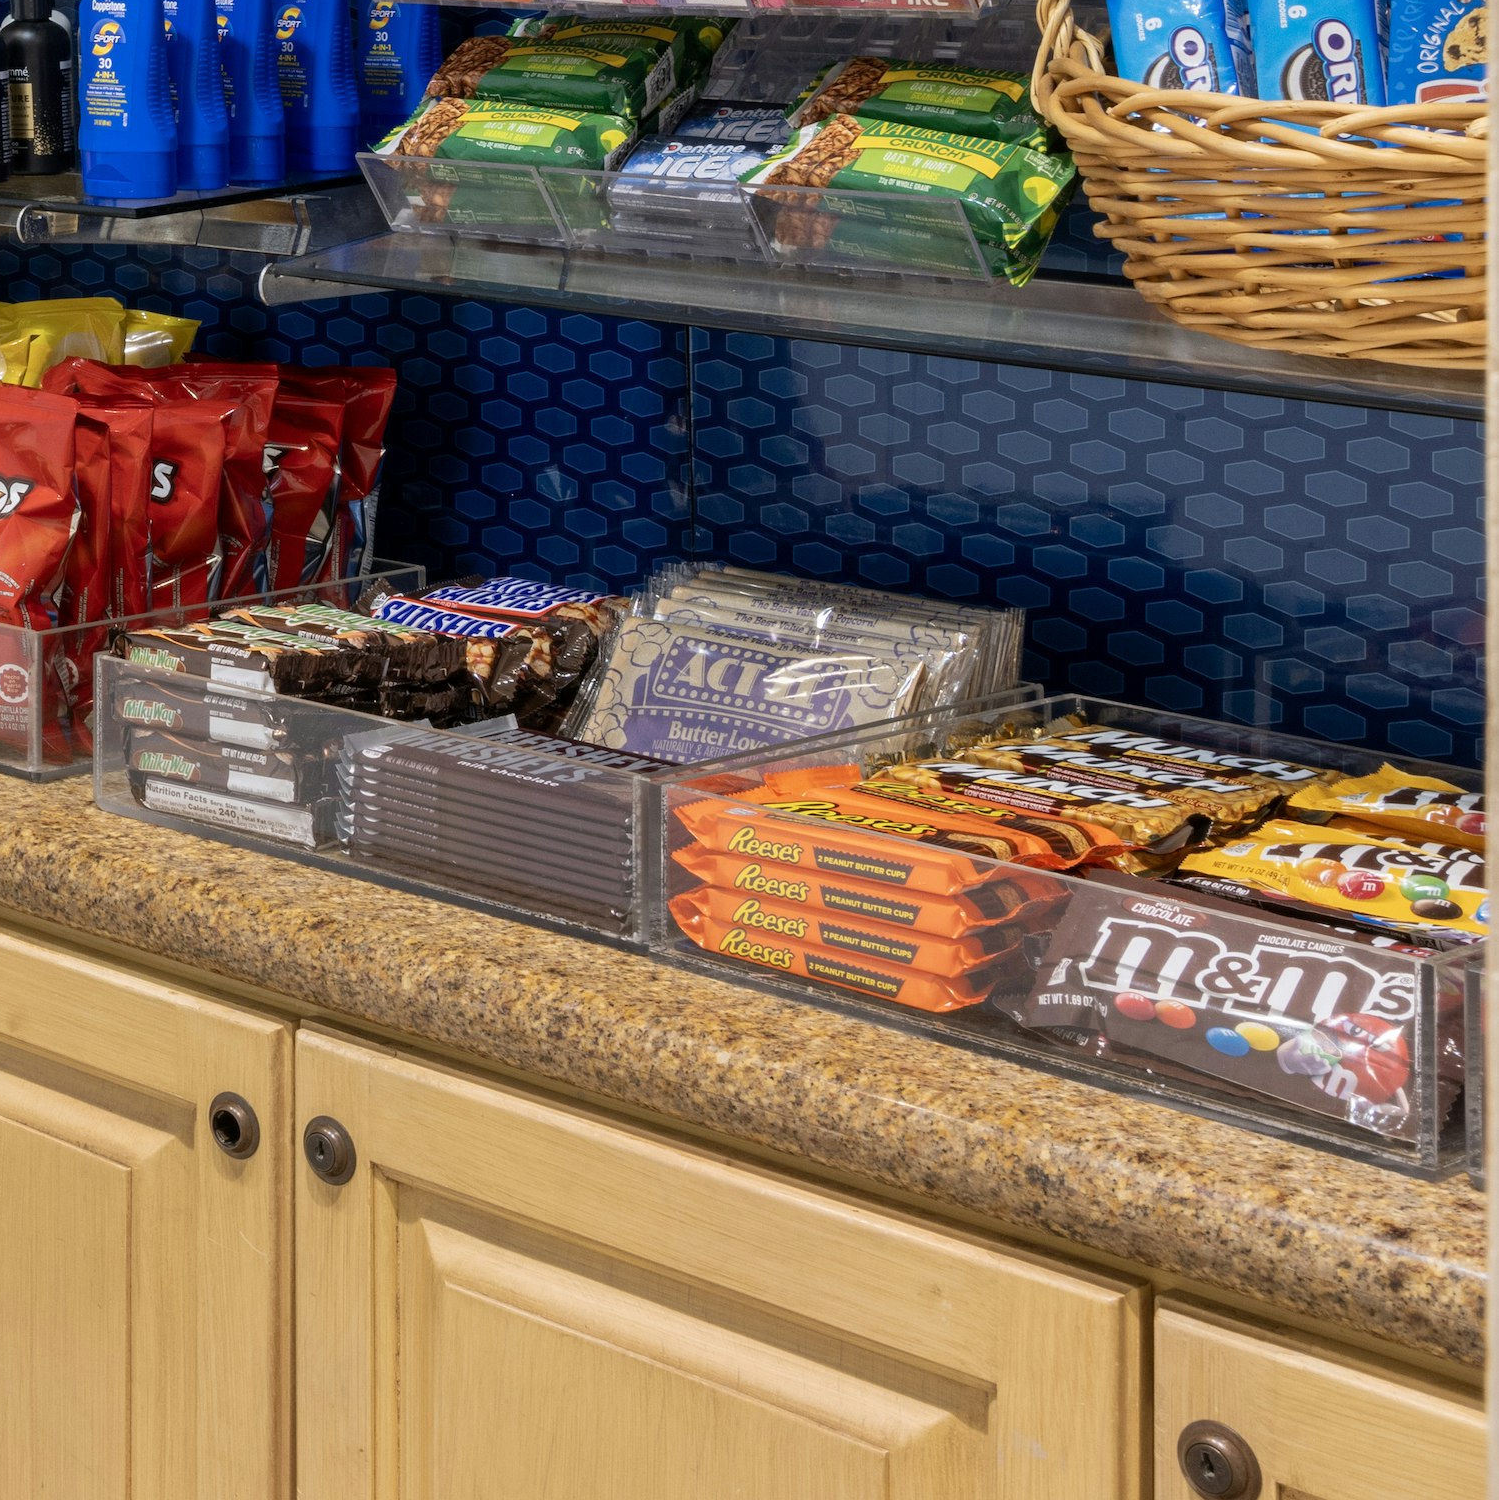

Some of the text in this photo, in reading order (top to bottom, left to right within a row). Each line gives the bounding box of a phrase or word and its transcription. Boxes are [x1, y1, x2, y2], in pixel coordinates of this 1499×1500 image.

[93, 34, 121, 43] SPORT
[95, 71, 116, 79] 4-IN-1
[98, 58, 112, 69] 30
[868, 121, 1007, 160] NATURE VALLEY
[889, 138, 972, 160] CRUNCHY
[735, 612, 754, 626] The
[756, 615, 777, 628] Best
[779, 620, 803, 634] Value
[805, 626, 816, 636] In
[672, 652, 768, 697] ACT
[668, 720, 728, 748] Butter
[395, 731, 603, 784] HERSHEY'S
[457, 760, 560, 788] milk chocolate
[916, 762, 1173, 809] MUNCH
[187, 803, 217, 816] Calories
[728, 826, 804, 863] Reese's
[817, 855, 906, 879] 2 PEANUT BUTTER CUPS
[1131, 902, 1195, 928] CHOCOLATE
[1258, 934, 1345, 954] CHOCOLATE CANDIES
